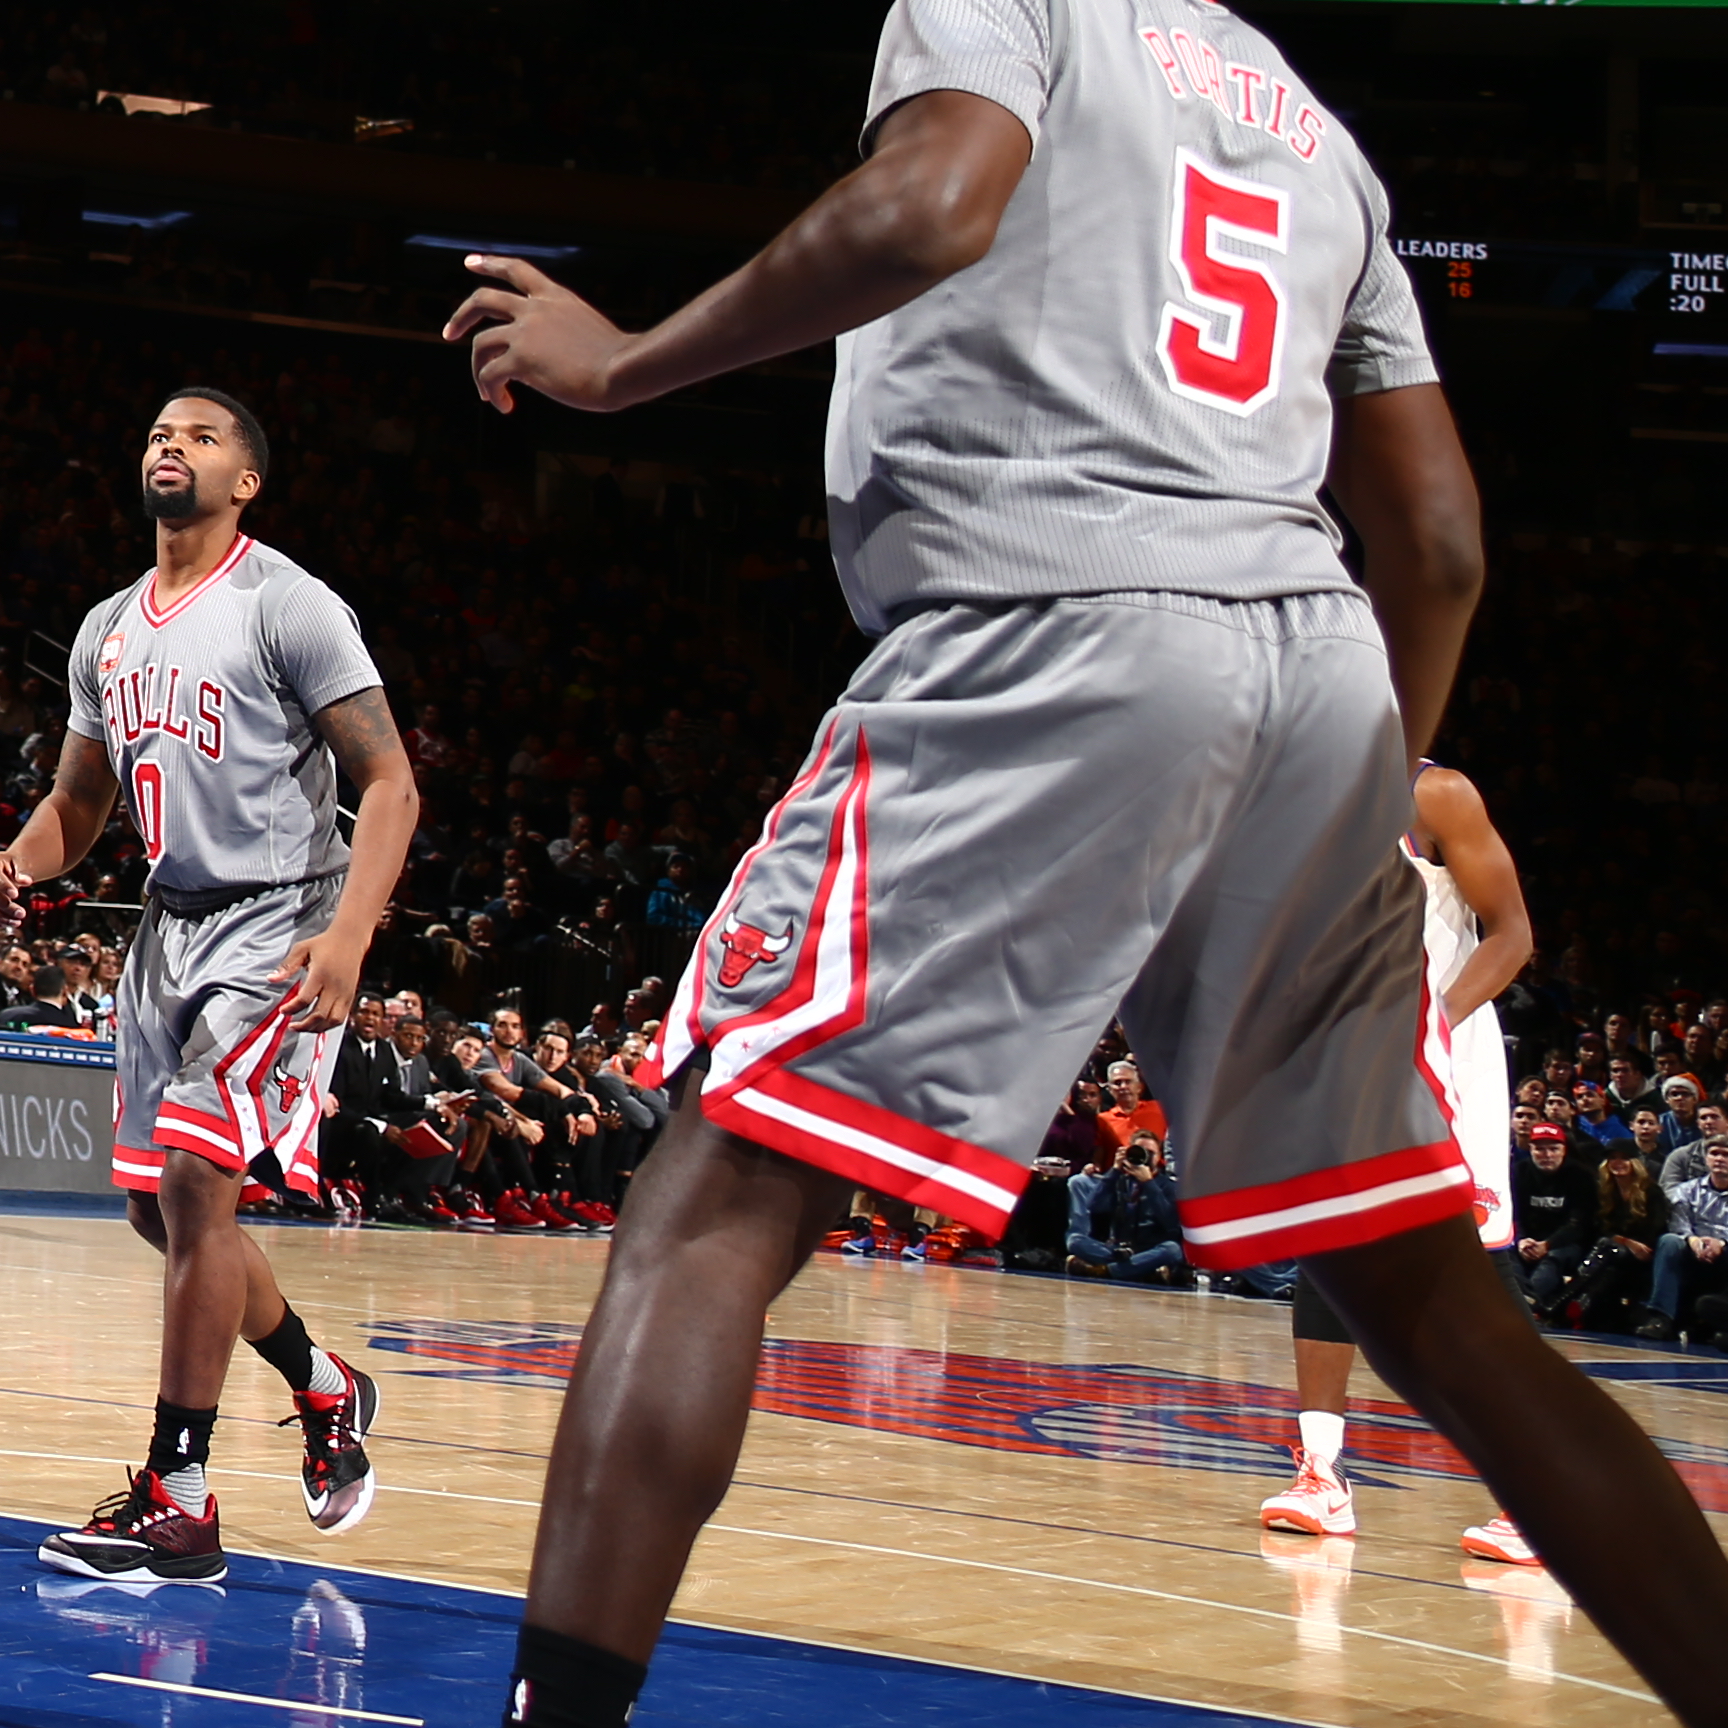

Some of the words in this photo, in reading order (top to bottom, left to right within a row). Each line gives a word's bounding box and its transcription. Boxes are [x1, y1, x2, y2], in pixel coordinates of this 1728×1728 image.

[1138, 26, 1326, 164] PORTIS
[1397, 240, 1489, 260] LEADERS
[1448, 262, 1472, 278] 25
[1670, 252, 1728, 271] TIME
[1156, 146, 1291, 418] 5
[1448, 282, 1472, 298] 16
[1671, 274, 1724, 293] FULL
[1670, 295, 1705, 312] :20
[102, 663, 226, 764] BULLS
[132, 758, 166, 865] 0
